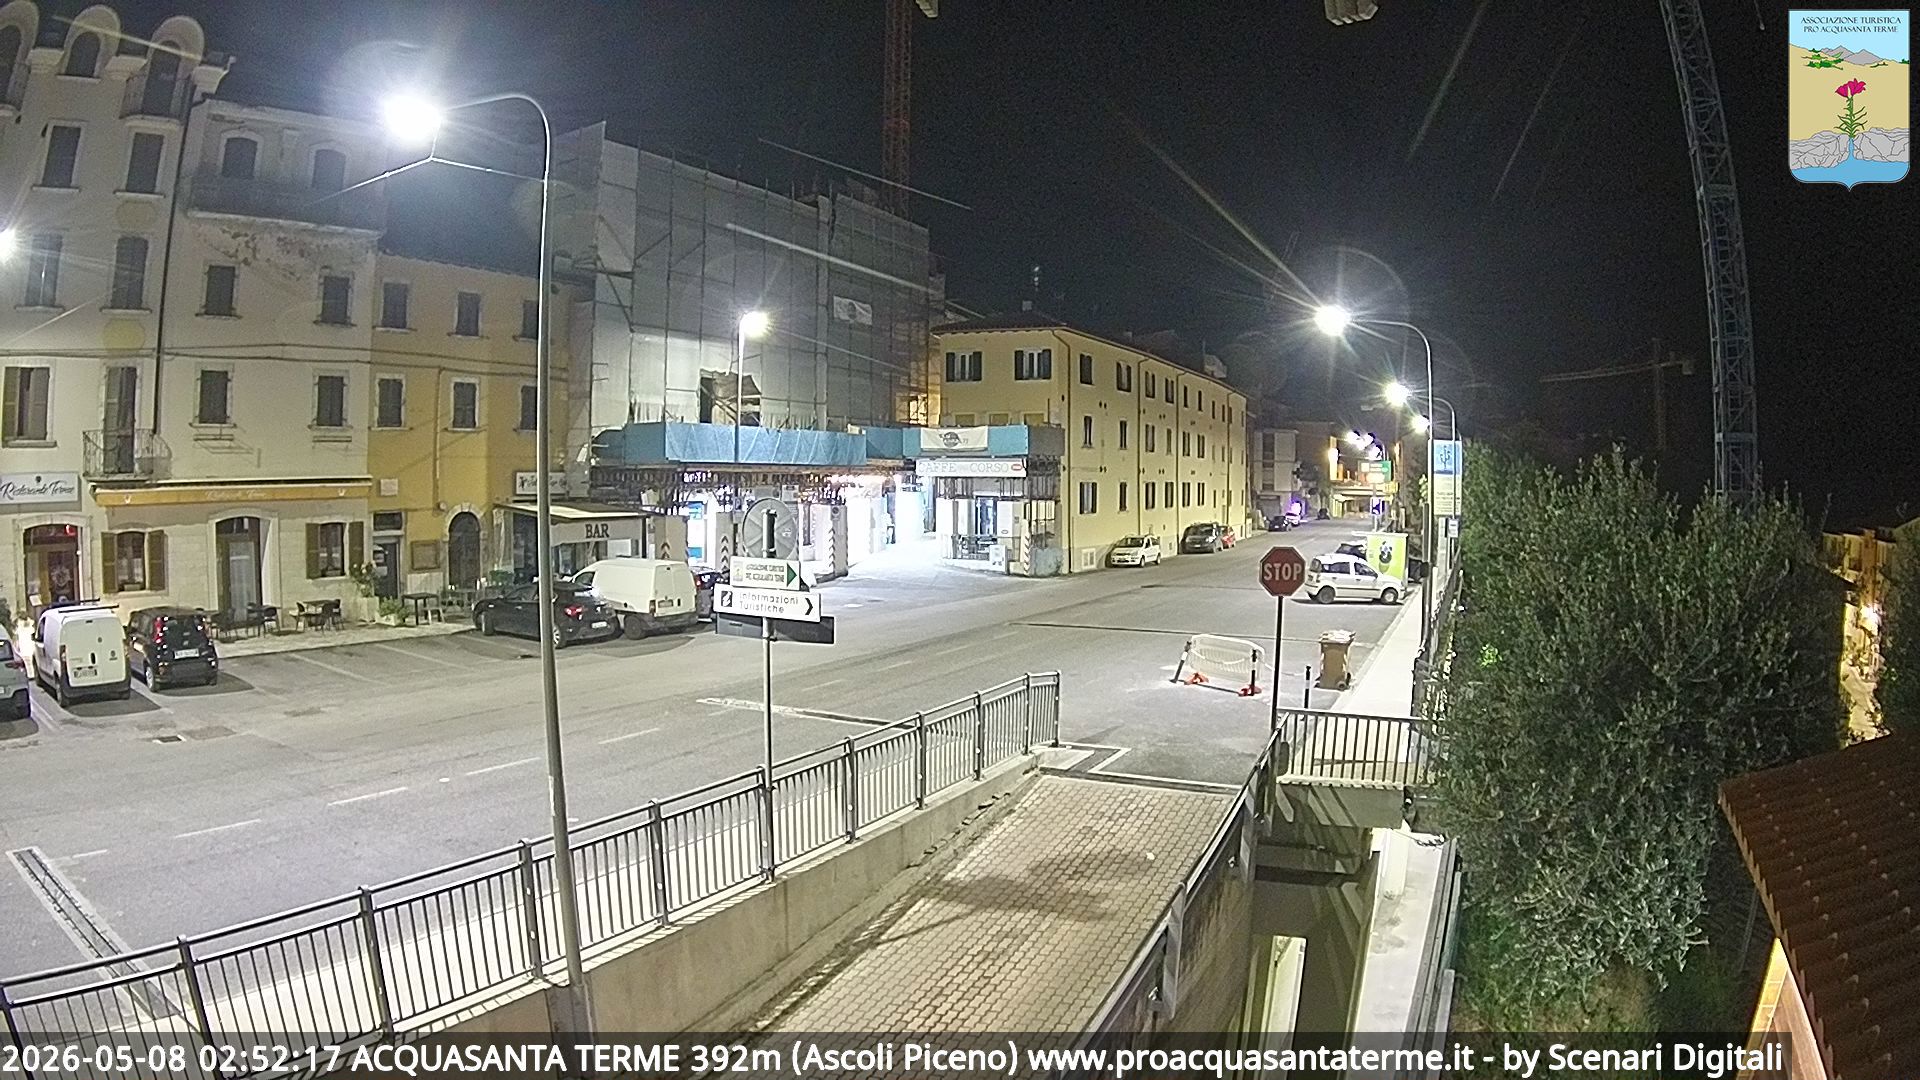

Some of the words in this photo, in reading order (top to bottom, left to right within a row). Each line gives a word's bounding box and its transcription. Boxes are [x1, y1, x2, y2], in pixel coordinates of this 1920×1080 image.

[969, 462, 1010, 473] CORSO
[585, 523, 610, 539] BAR
[1263, 562, 1303, 581] STOP
